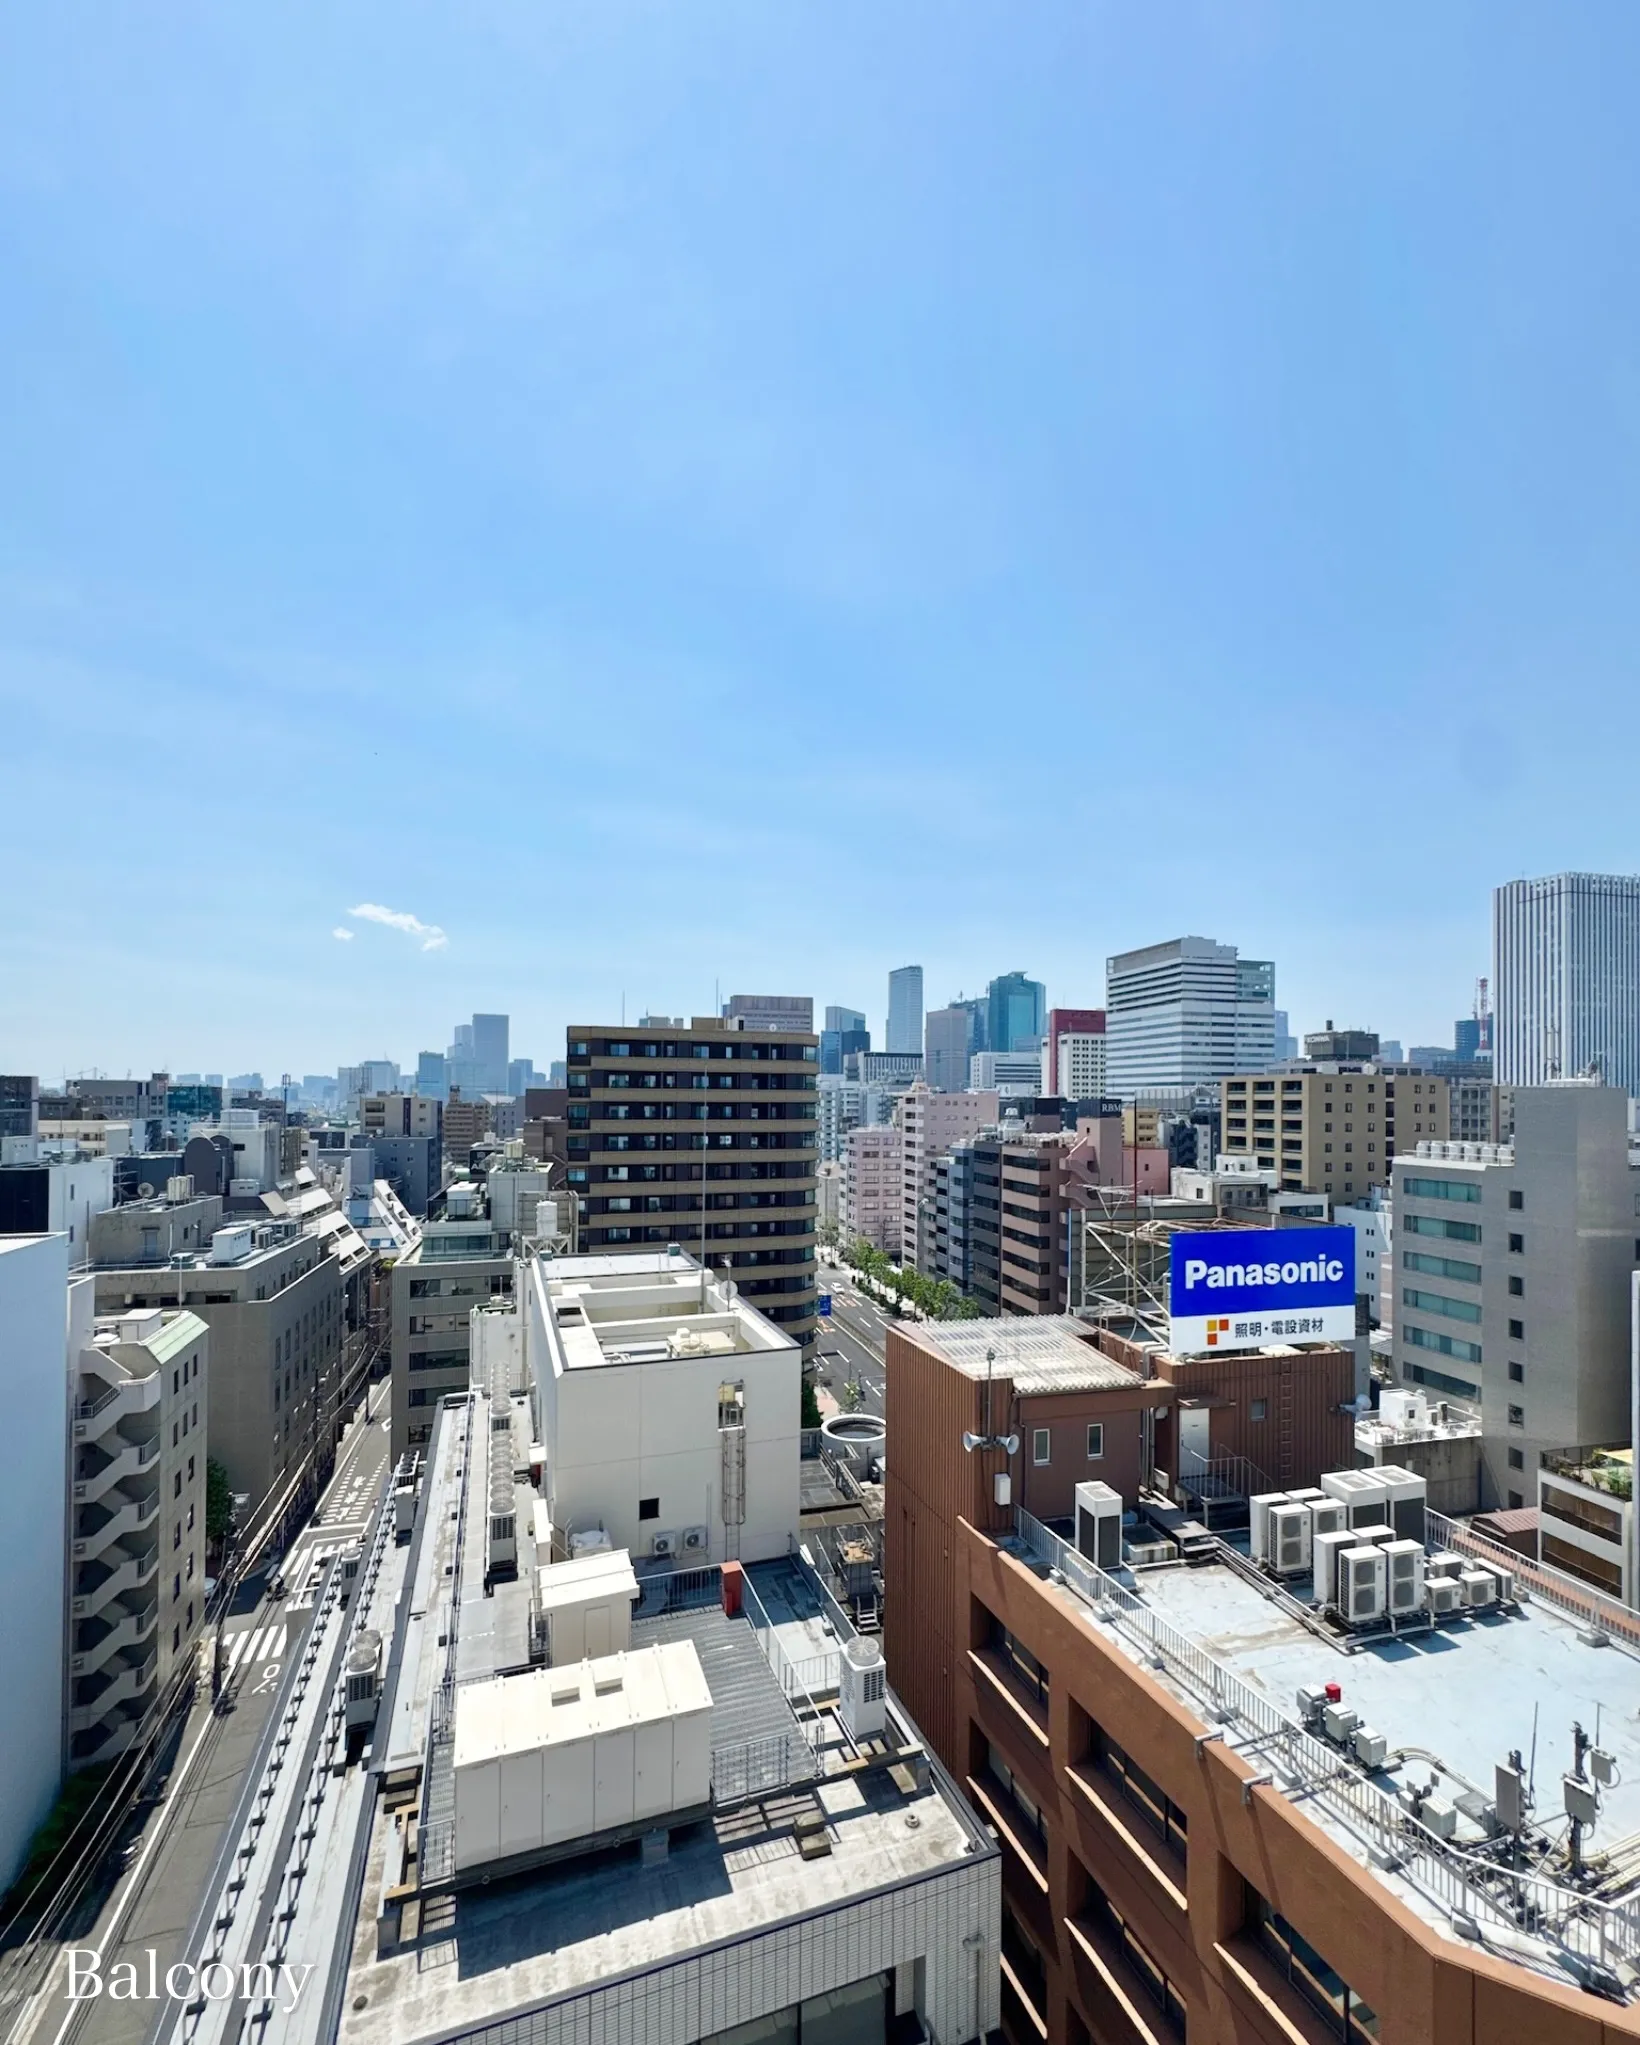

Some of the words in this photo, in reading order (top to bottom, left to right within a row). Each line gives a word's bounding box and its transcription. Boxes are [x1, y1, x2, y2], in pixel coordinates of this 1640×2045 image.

[1101, 1103, 1121, 1112] RBM
[1185, 1253, 1344, 1290] Panasonic
[1234, 1317, 1324, 1338] 照明・電設資材
